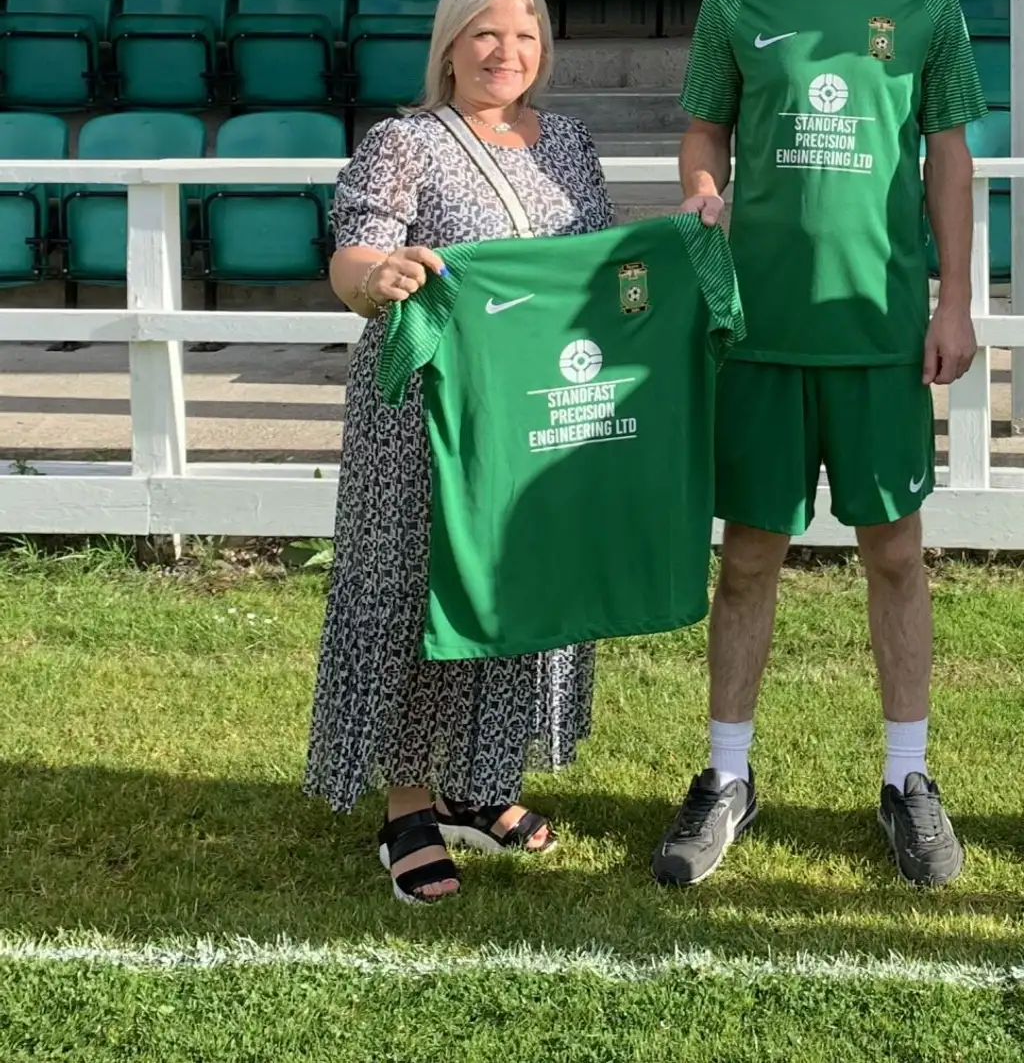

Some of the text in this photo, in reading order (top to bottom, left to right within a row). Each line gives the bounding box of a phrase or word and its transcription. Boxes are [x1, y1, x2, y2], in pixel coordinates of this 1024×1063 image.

[794, 117, 858, 134] STANDFAST
[795, 133, 855, 149] PRECISION
[776, 149, 873, 168] ENGINEERING LTD
[548, 384, 616, 407] STANDFAST
[551, 402, 615, 425] PRECISION
[529, 418, 637, 447] ENGINEERING LTD
